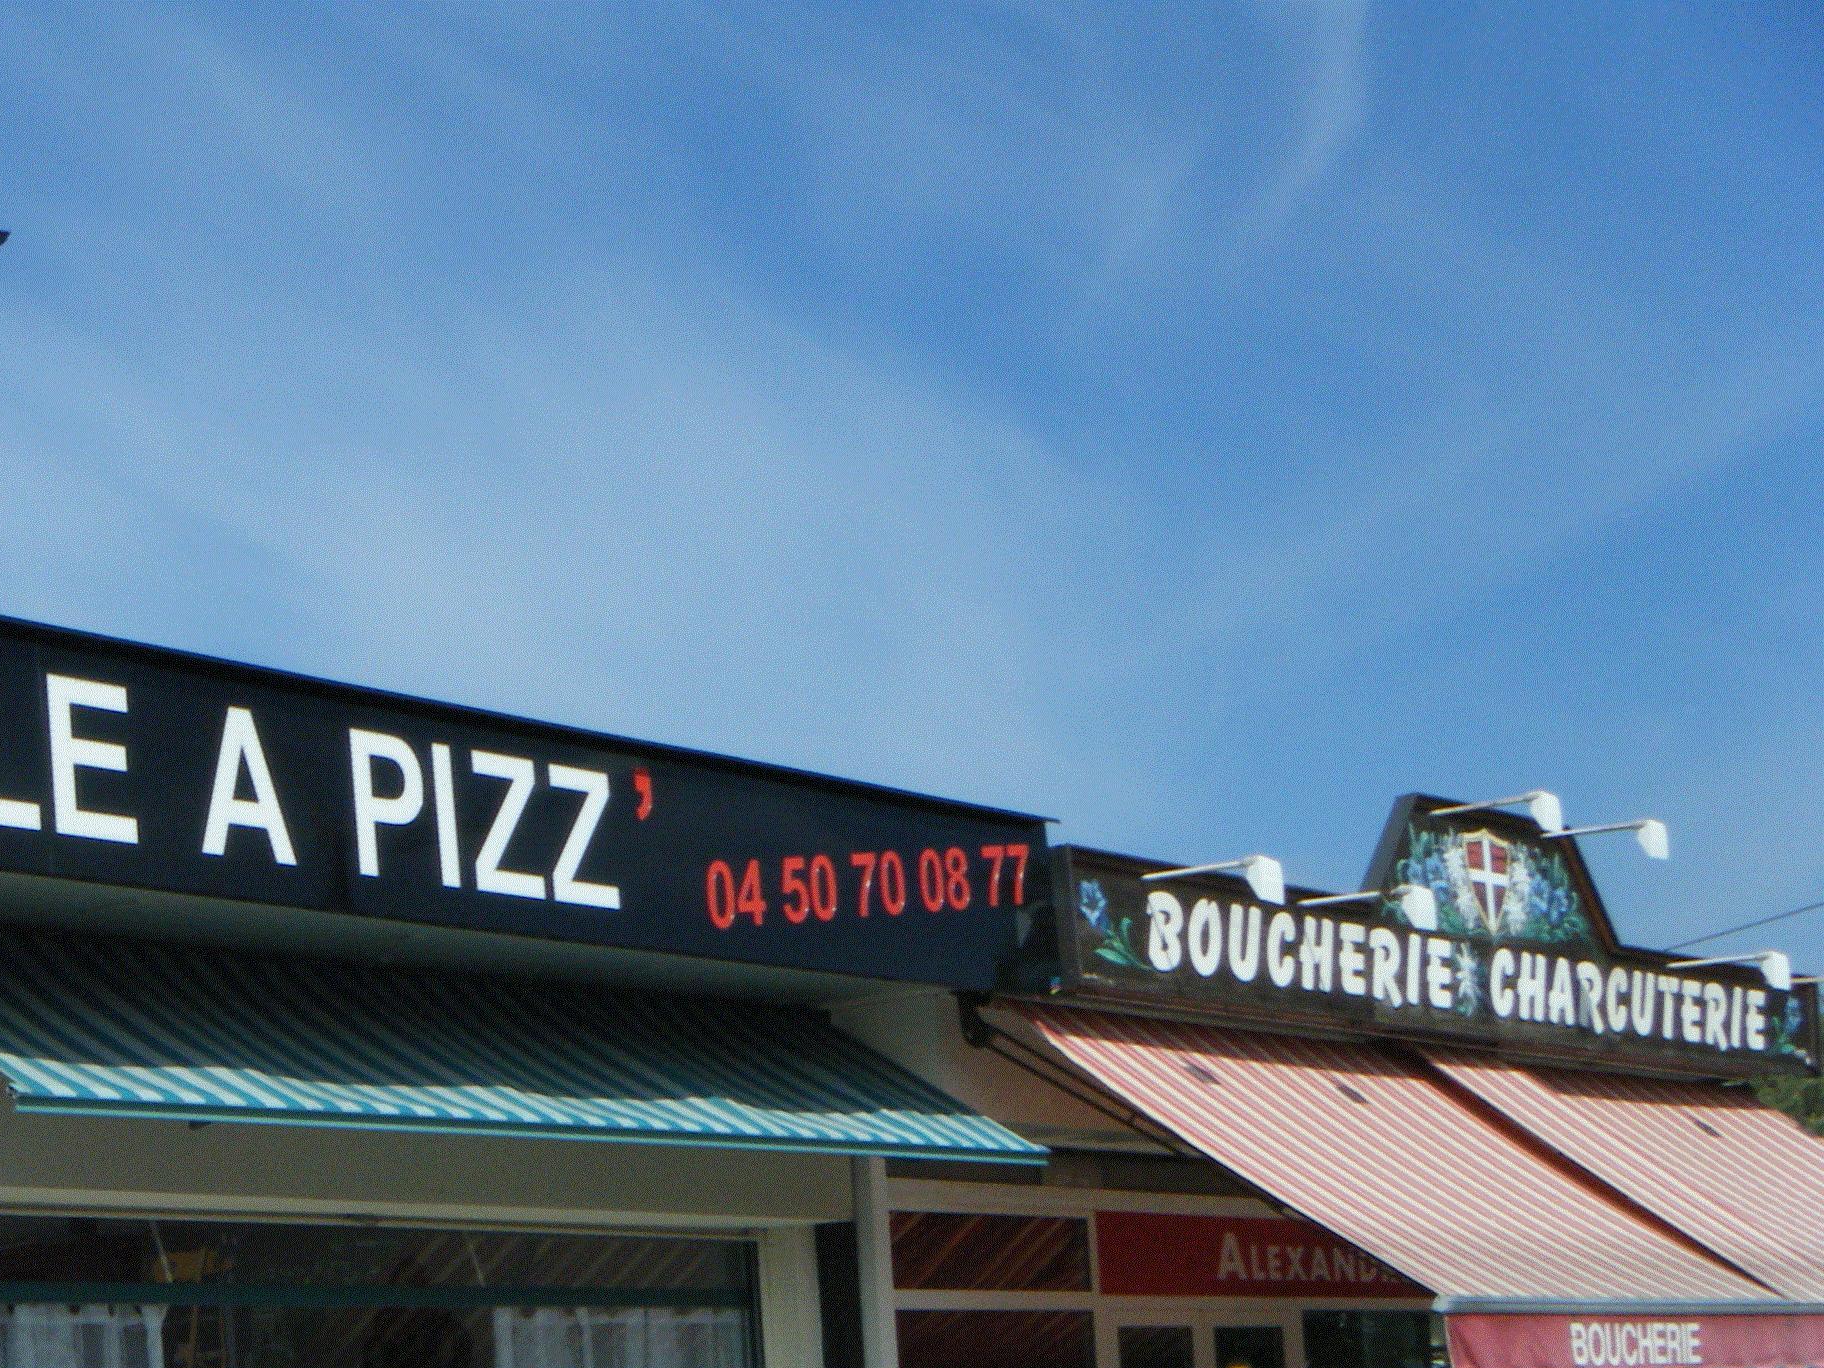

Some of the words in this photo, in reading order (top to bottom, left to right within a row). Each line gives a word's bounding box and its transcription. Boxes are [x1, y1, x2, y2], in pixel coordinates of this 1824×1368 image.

[201, 705, 298, 867] A
[705, 858, 766, 931] 04
[781, 853, 839, 925] 50
[851, 849, 906, 919] 70
[919, 846, 972, 914] 08
[981, 843, 1031, 906] 77
[1146, 890, 1455, 1009] BOUCHERIE
[1490, 948, 1768, 1052] CHARCUTERIE
[1569, 1321, 1703, 1367] BOUCHERIE
